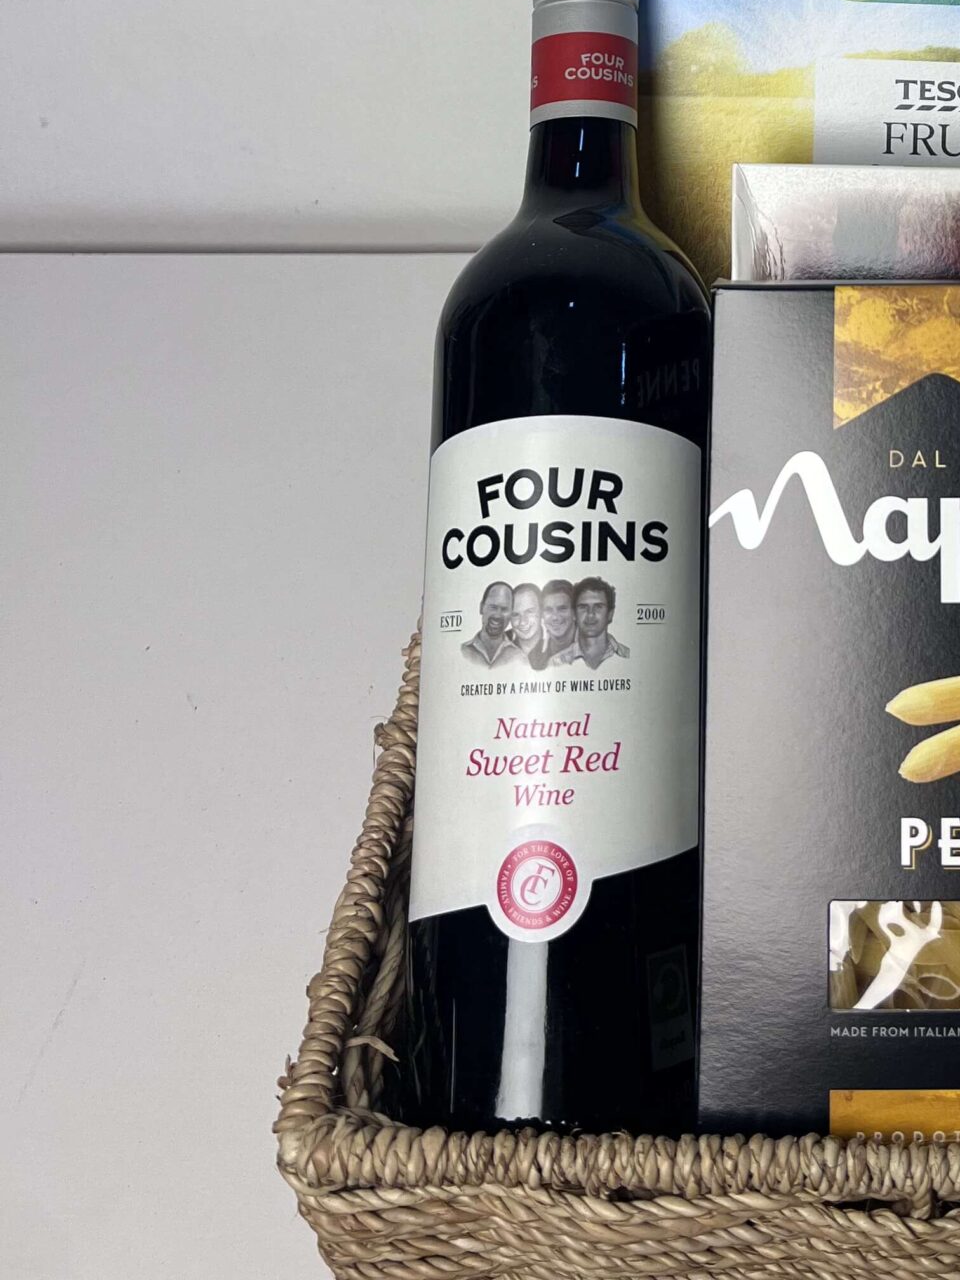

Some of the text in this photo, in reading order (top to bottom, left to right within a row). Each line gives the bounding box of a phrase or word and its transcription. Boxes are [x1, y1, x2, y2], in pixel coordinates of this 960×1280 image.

[580, 52, 625, 70] FOUR
[564, 67, 634, 88] COUSINS
[889, 450, 947, 469] DAL
[477, 467, 624, 519] FOUR
[442, 521, 669, 569] COUSINS
[440, 615, 462, 628] ESTD
[636, 607, 665, 620] 2000
[460, 679, 631, 696] CREATED BY A FAMILY OF WINE LOVERS
[493, 713, 591, 739] Natural
[466, 742, 622, 776] Sweet Red
[513, 783, 575, 807] Wine
[512, 845, 574, 882] FOR THE LOVE OF
[552, 894, 572, 917] WINE
[830, 1026, 867, 1038] MADE
[872, 1026, 909, 1037] FROM
